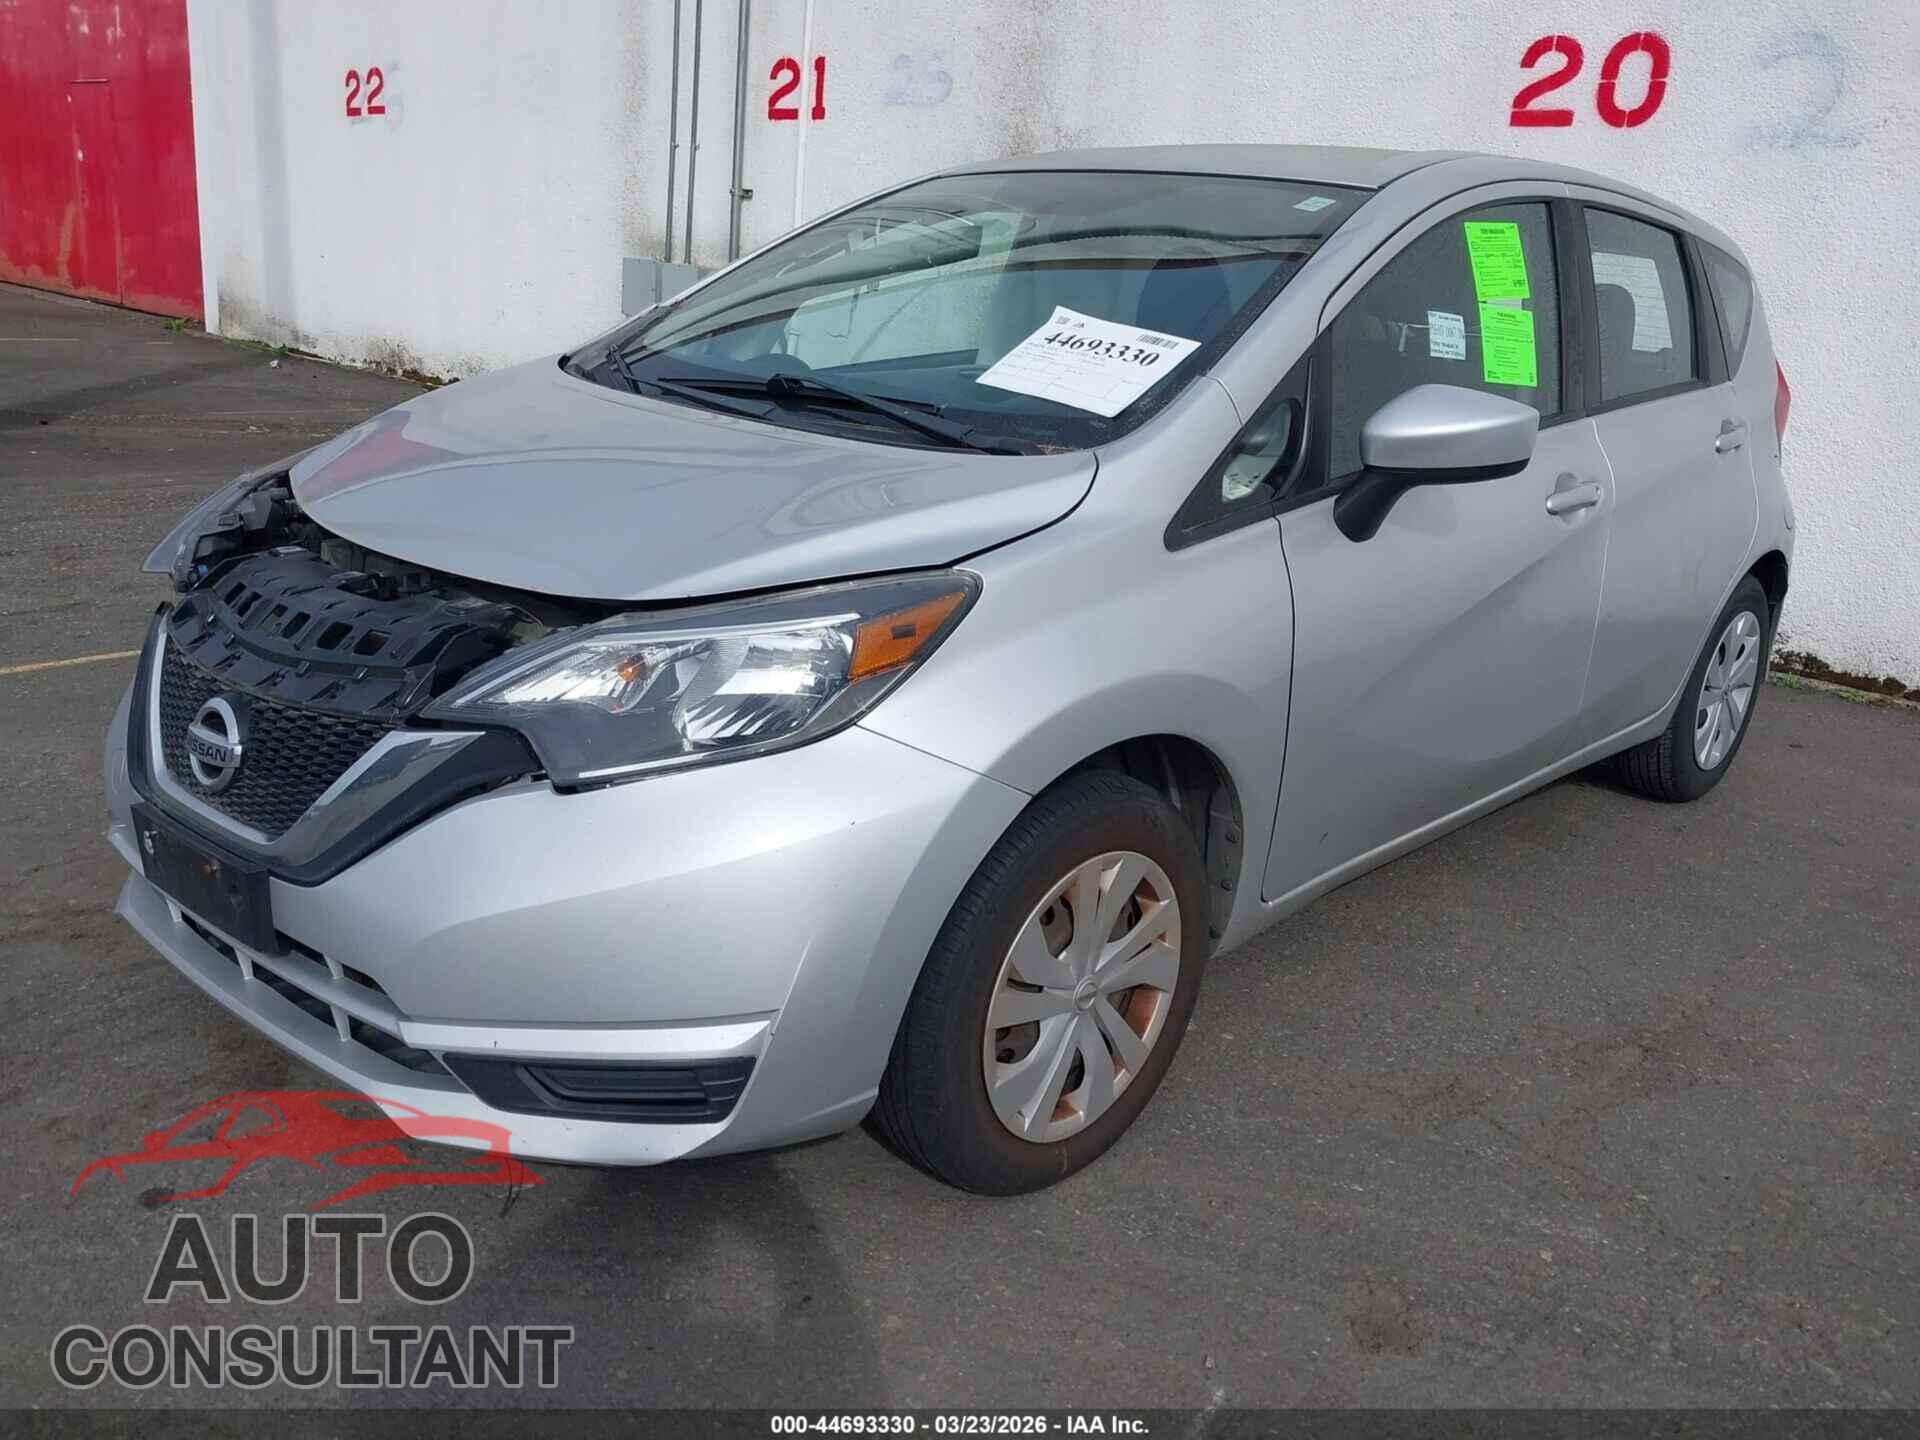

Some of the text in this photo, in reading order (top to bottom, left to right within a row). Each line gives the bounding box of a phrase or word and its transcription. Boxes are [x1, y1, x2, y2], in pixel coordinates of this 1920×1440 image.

[345, 67, 386, 118] 22
[767, 55, 827, 122] 21
[1509, 31, 1671, 129] 20
[1043, 331, 1161, 368] 44693330
[189, 737, 227, 763] SSAN
